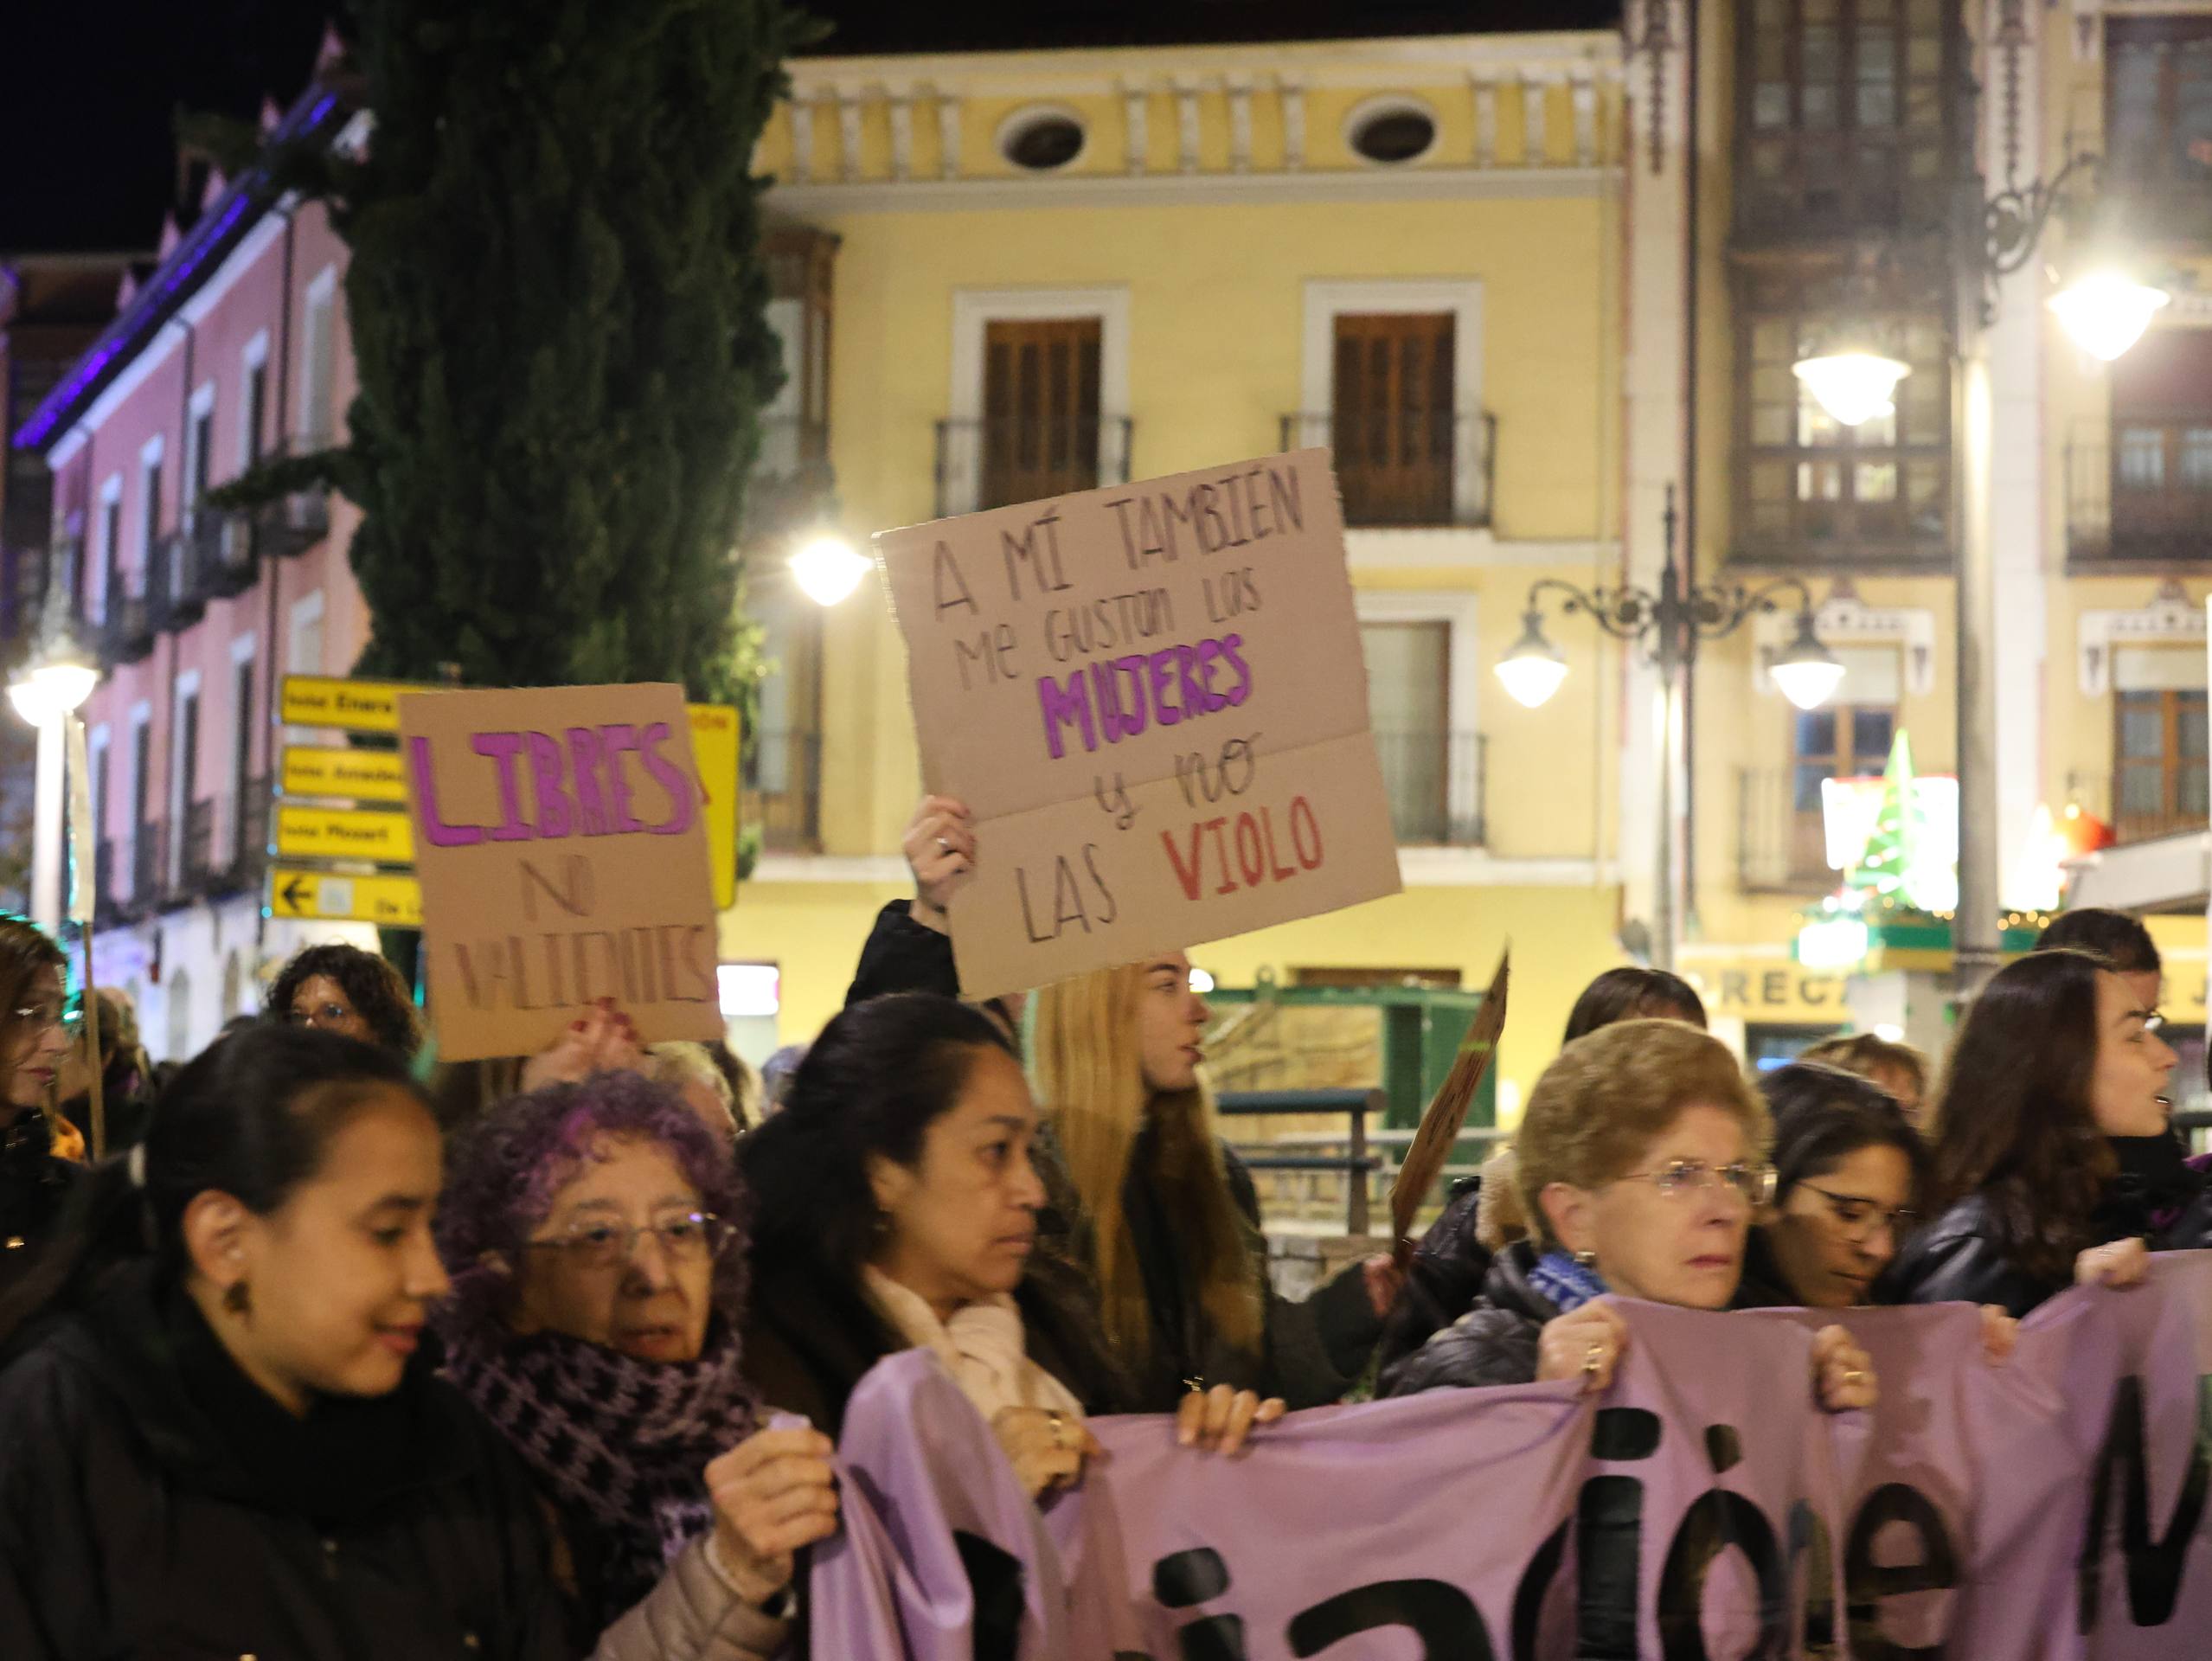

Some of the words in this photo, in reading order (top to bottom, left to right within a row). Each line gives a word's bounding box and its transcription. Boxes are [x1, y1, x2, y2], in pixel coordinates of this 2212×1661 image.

[933, 541, 979, 620] A
[1037, 633, 1252, 759] MUJERES
[409, 722, 695, 846] LIBRES
[1016, 843, 1118, 945] LAS
[1160, 795, 1324, 901] VIOLO
